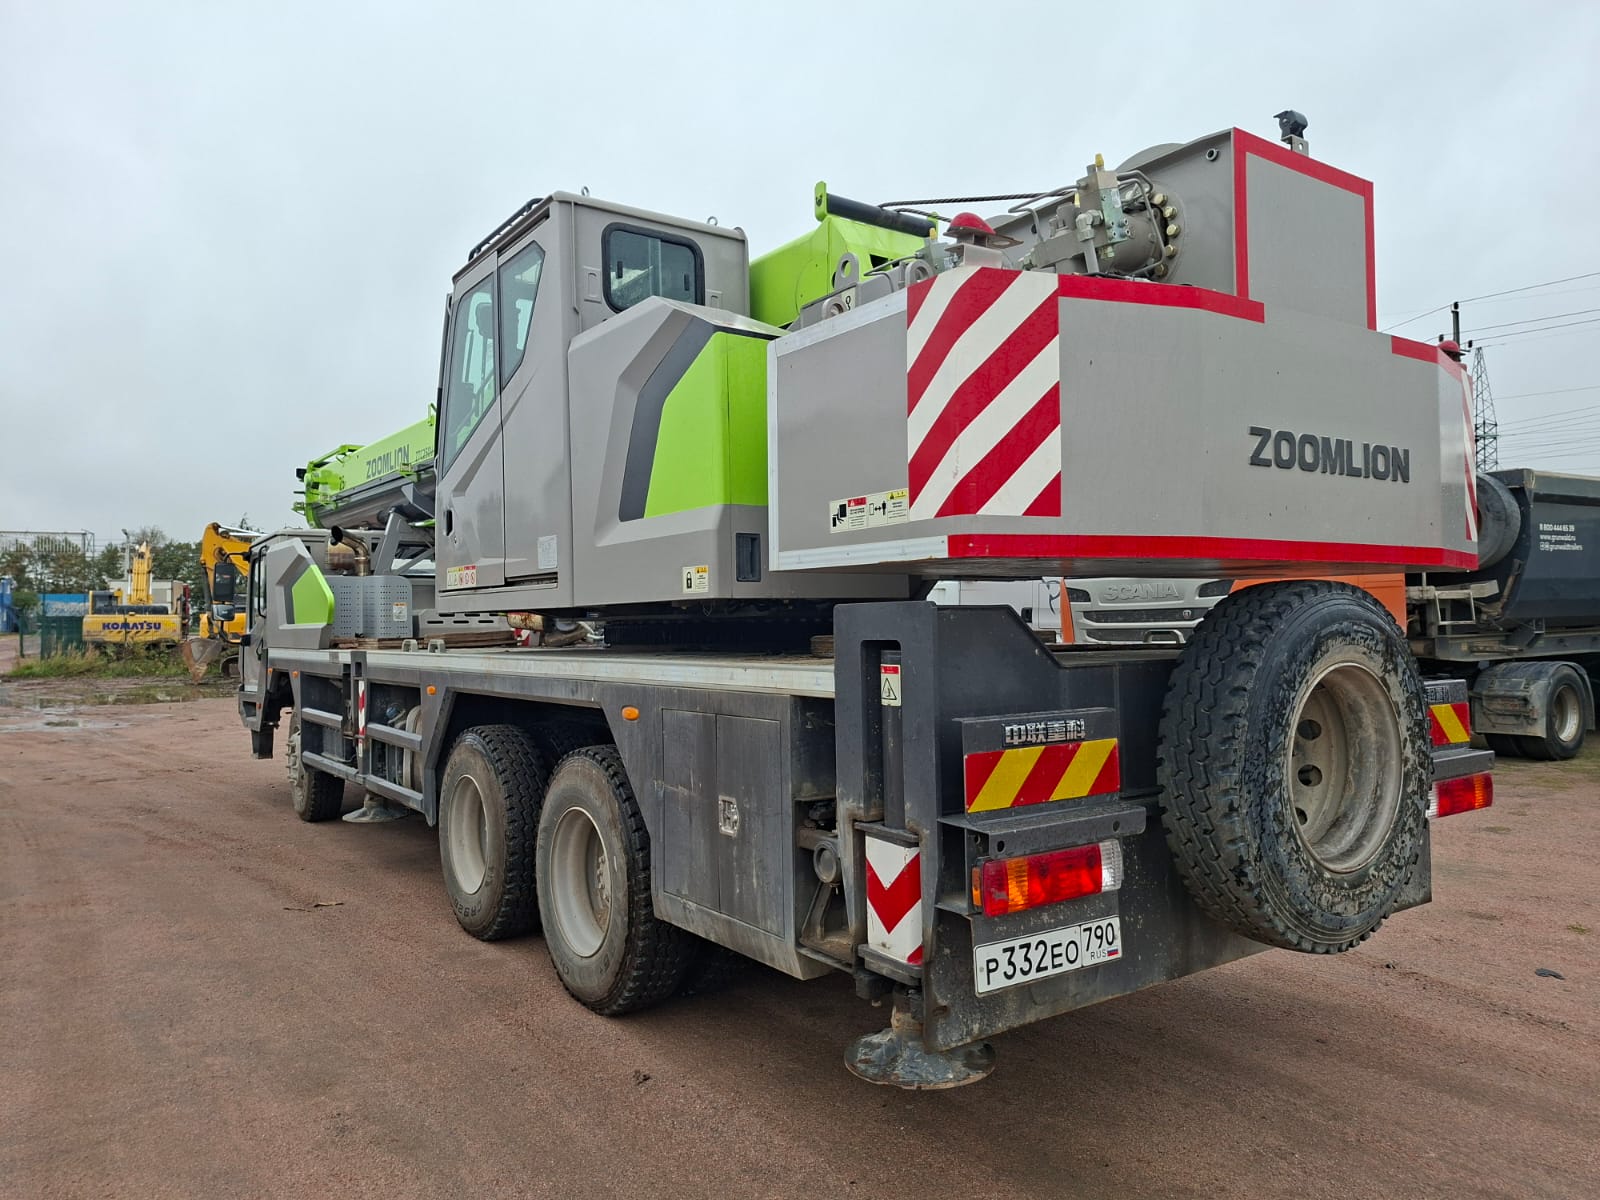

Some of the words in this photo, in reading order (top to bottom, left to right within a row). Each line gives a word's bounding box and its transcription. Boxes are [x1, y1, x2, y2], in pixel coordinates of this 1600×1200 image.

[366, 443, 410, 479] ZOOMLION
[1248, 426, 1410, 483] ZOOMLION
[1104, 583, 1179, 600] SCANIA
[102, 620, 162, 630] KOMATSU
[1005, 719, 1086, 745] 中联重科
[986, 940, 1079, 985] P332EO
[1082, 922, 1115, 952] 790
[1090, 949, 1107, 960] RUS
